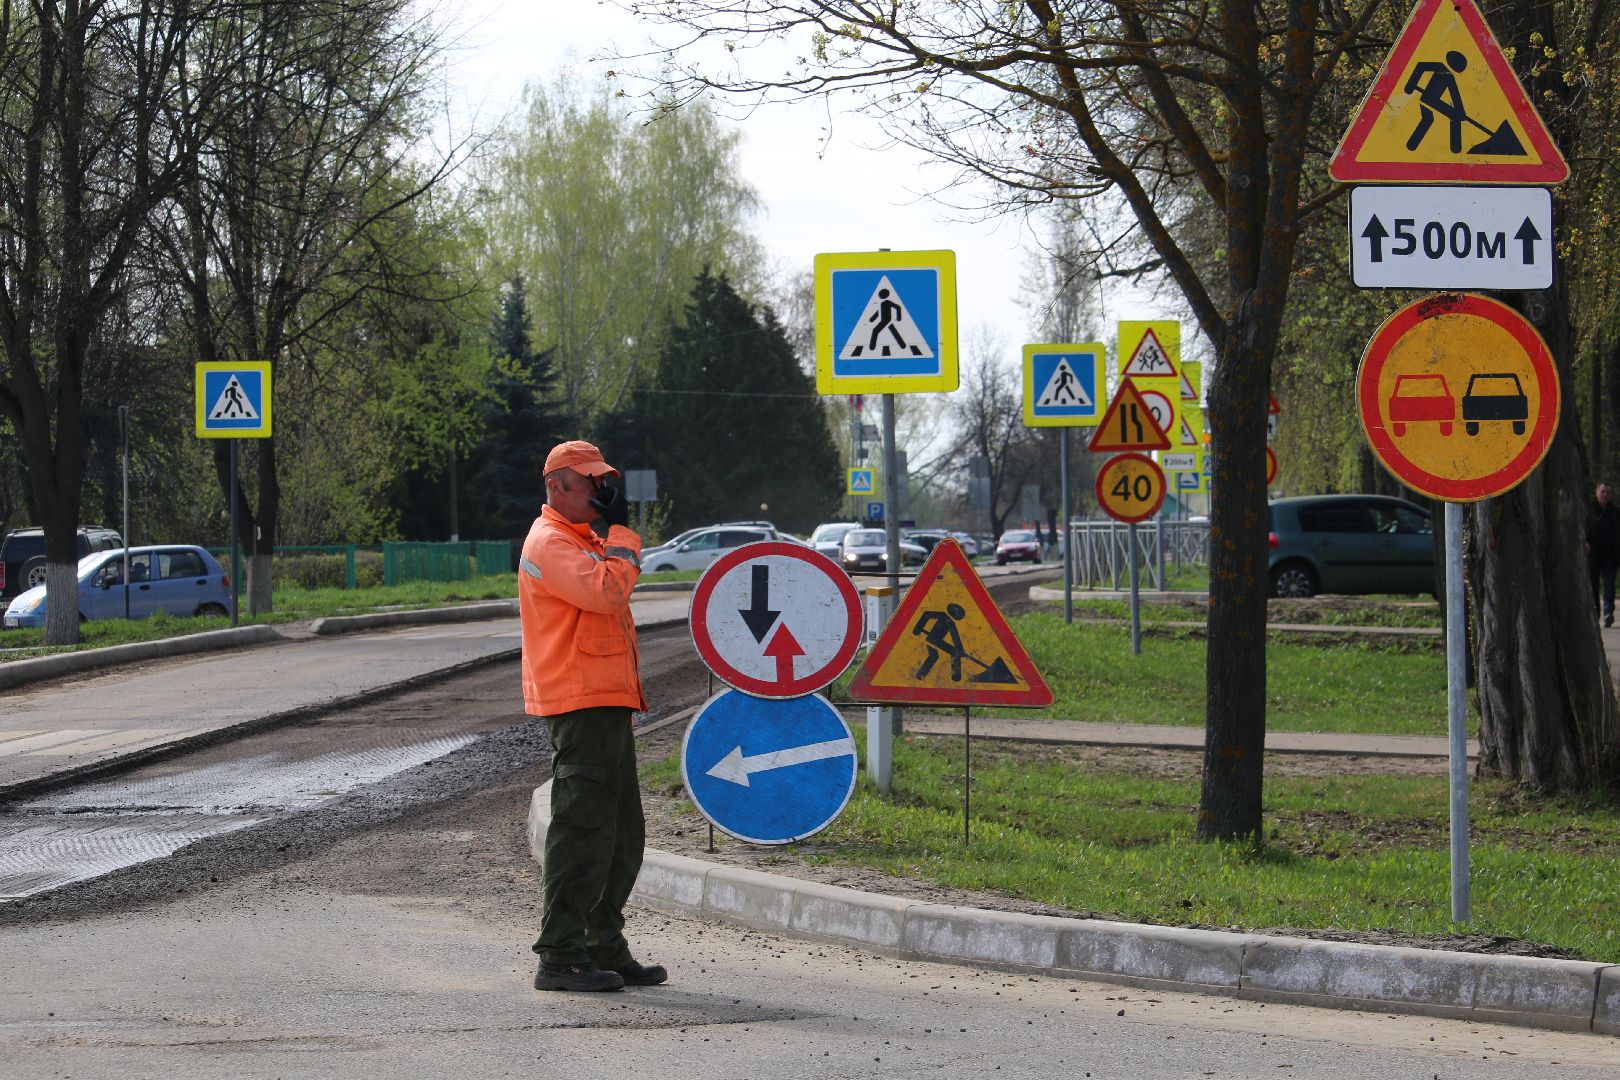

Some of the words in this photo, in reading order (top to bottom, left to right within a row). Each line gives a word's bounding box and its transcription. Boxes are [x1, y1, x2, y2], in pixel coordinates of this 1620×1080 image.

[1391, 218, 1506, 260] 500м
[1111, 475, 1152, 502] 40
[870, 504, 881, 518] P
